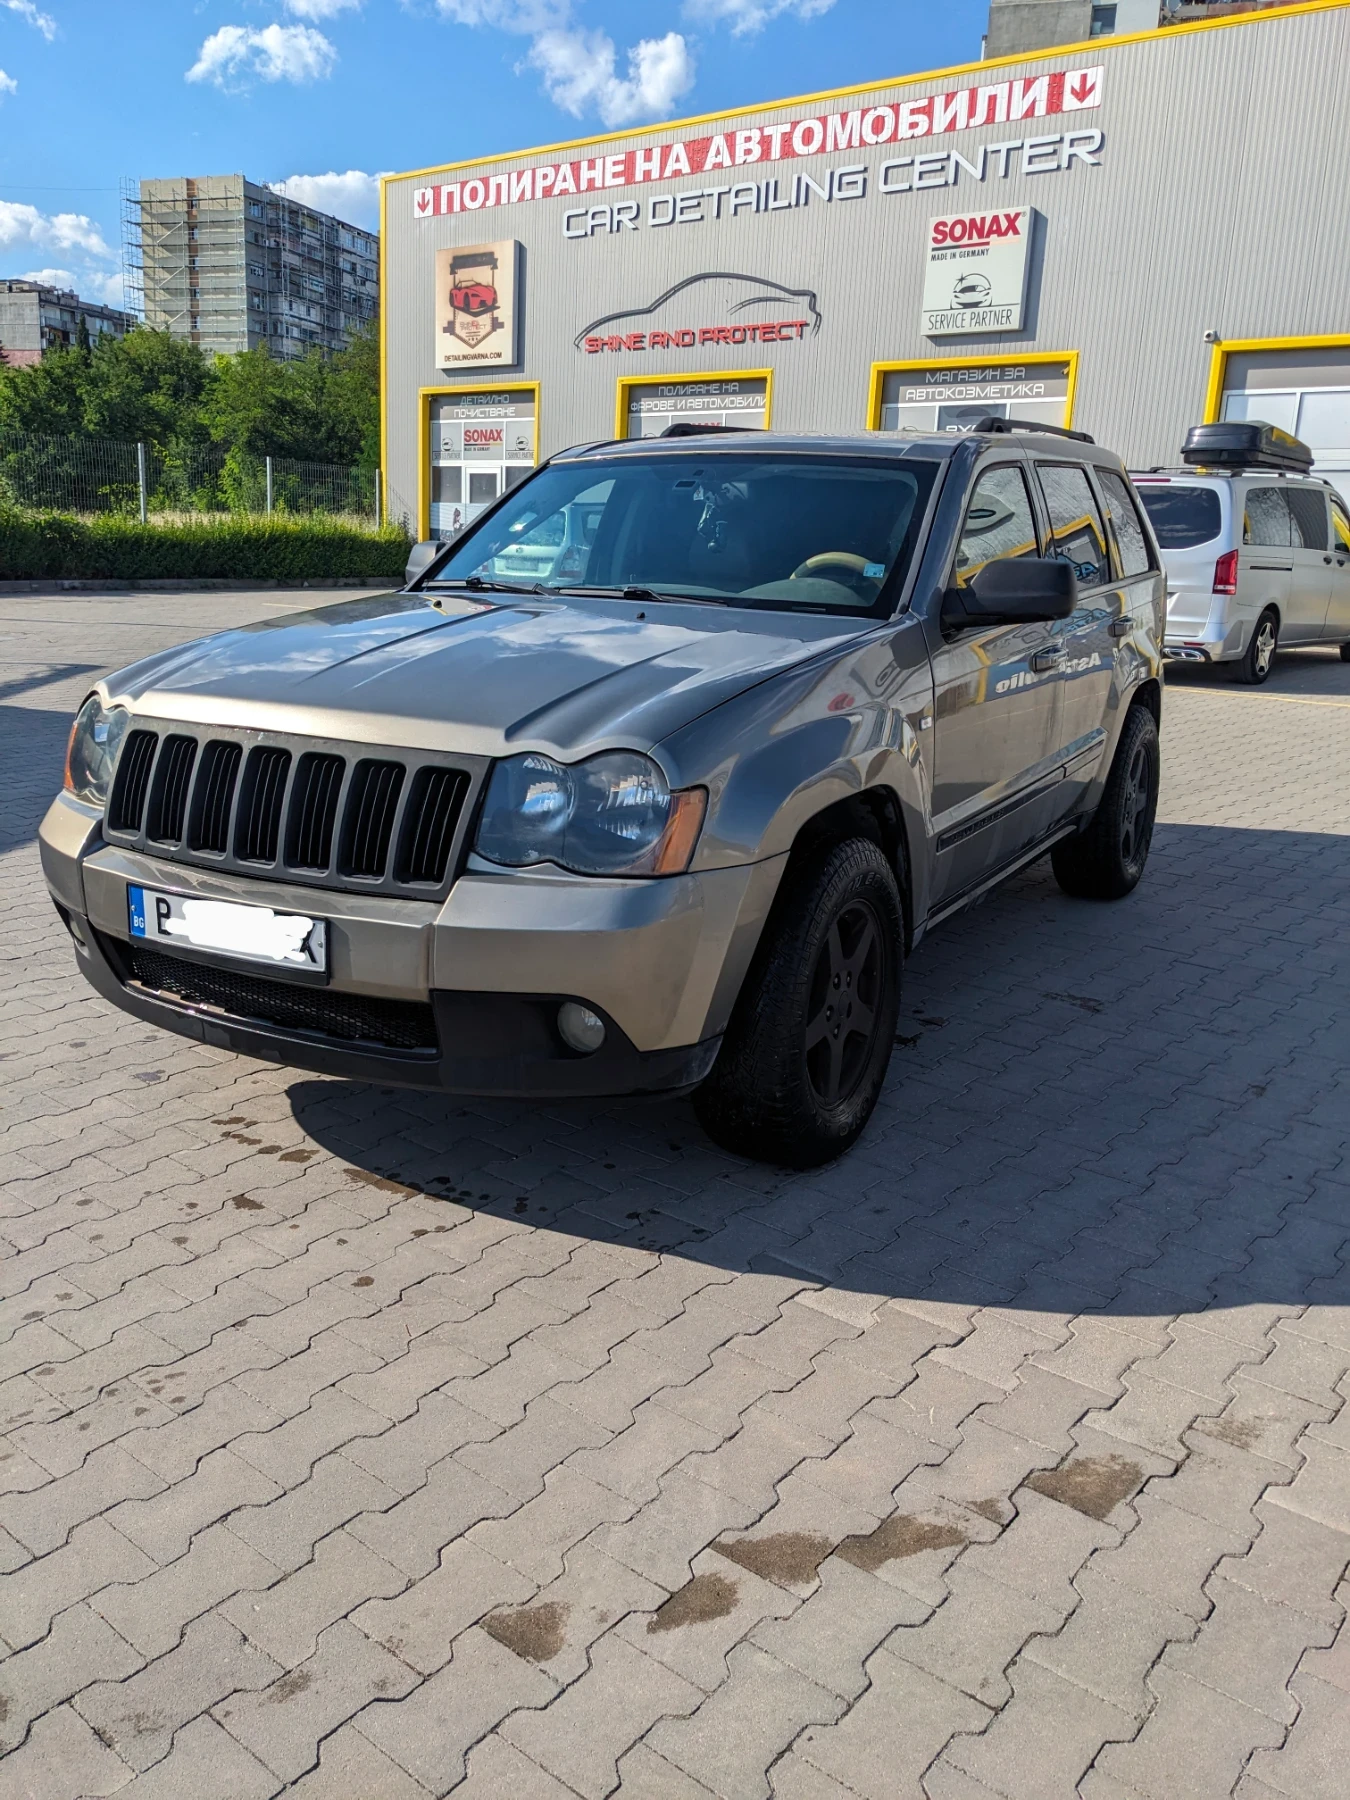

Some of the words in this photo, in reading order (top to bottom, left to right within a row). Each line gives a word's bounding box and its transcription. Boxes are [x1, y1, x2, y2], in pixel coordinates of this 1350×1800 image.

[440, 153, 626, 214] ПОЛИРАНЕ
[635, 142, 692, 183] НА
[703, 75, 1050, 171] АВТОМОБИЛИ
[562, 200, 639, 239] CAR
[647, 163, 868, 228] DETAILING
[878, 128, 1103, 195] CENTER
[931, 212, 1022, 245] SONAX
[930, 253, 948, 262] MADE
[949, 252, 957, 260] IN
[958, 248, 990, 259] GERMANY
[928, 312, 967, 331] SERVICE
[969, 308, 1013, 328] PARTNER
[585, 333, 646, 353] SHINE
[649, 329, 694, 350] AND
[699, 321, 807, 345] PROTECT
[444, 351, 503, 362] DETAILINGVARNA.COM
[925, 367, 1000, 384] МАГАЗИН
[1003, 366, 1026, 380] ЗА
[658, 383, 721, 396] ПОЛИРАНЕ
[722, 382, 739, 393] НА
[905, 383, 1045, 401] АВТОКОЗМЕТИКА
[460, 394, 510, 407] ДЕТАЙЛНО
[630, 400, 675, 412] ФАРОВЕ
[677, 399, 686, 410] И
[453, 407, 516, 418] ПОЧИСТВАНЕ
[463, 428, 504, 443] SONAX
[133, 915, 145, 929] BG
